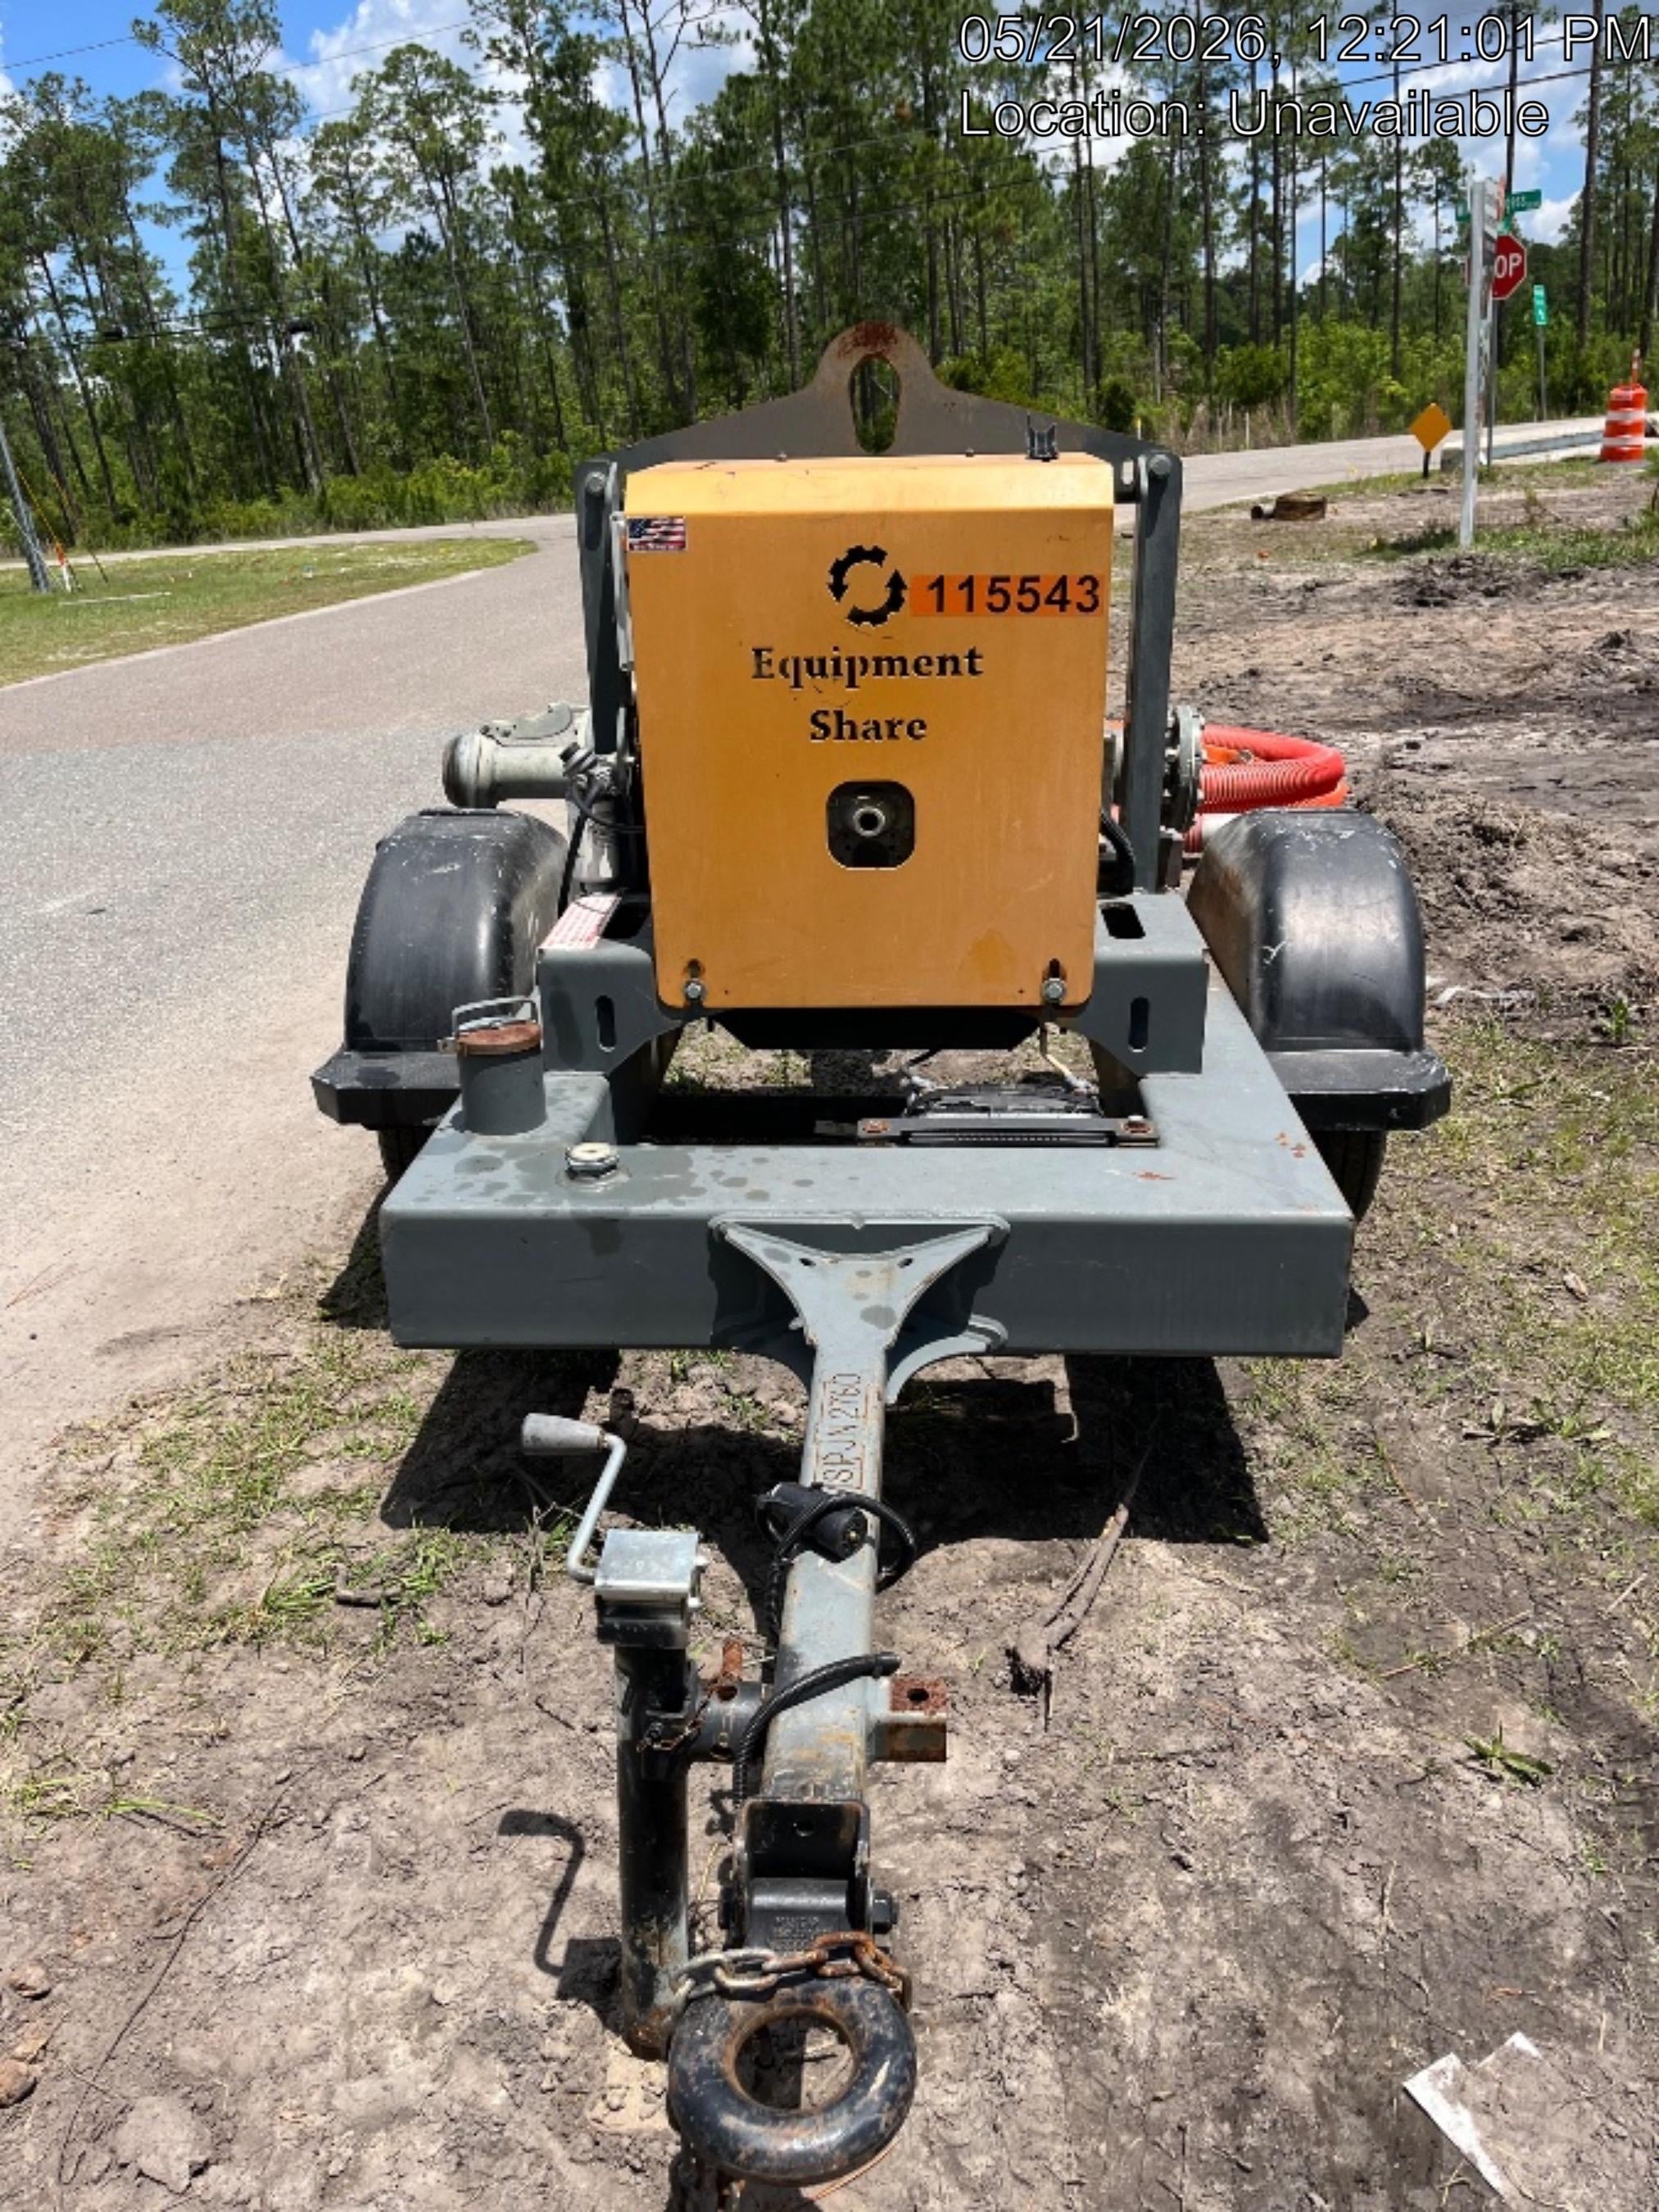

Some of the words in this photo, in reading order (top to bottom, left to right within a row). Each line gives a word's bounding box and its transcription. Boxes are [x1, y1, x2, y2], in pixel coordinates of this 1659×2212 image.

[1494, 252, 1522, 279] OP
[927, 575, 1100, 614] 115543
[750, 646, 984, 691] Equipment
[809, 710, 928, 742] Share
